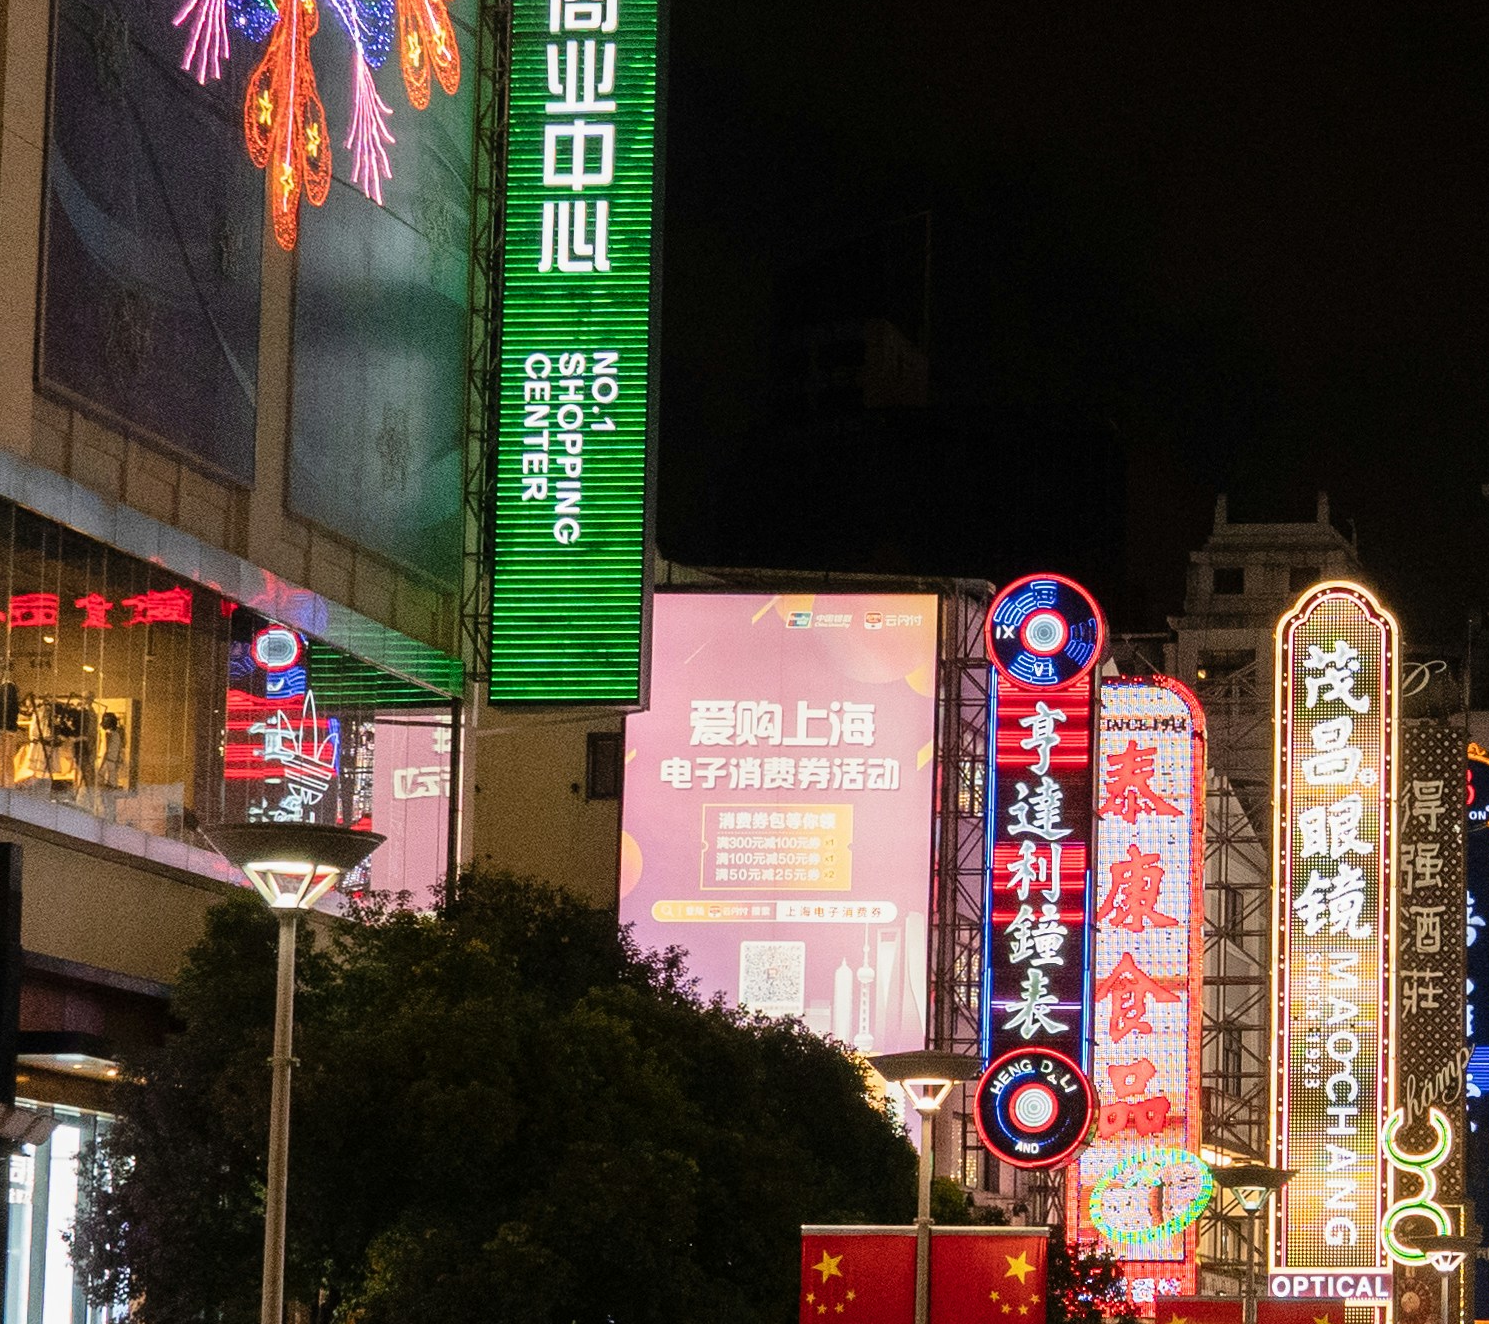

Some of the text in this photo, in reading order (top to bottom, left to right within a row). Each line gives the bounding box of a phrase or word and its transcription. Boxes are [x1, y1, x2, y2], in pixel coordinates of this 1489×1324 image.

[521, 354, 549, 503] CENTER
[590, 352, 618, 432] NO.1
[555, 353, 583, 546] SHOPPING
[660, 756, 900, 790] 电子消费券活动
[689, 700, 877, 747] 爱购上海
[1293, 641, 1374, 940] 茂昌眼镜
[1096, 738, 1184, 1141] 泰康食品
[989, 1059, 1034, 1095] HENG
[1323, 952, 1360, 1247] MAOCHANG
[1270, 1274, 1389, 1299] OPTICAL
